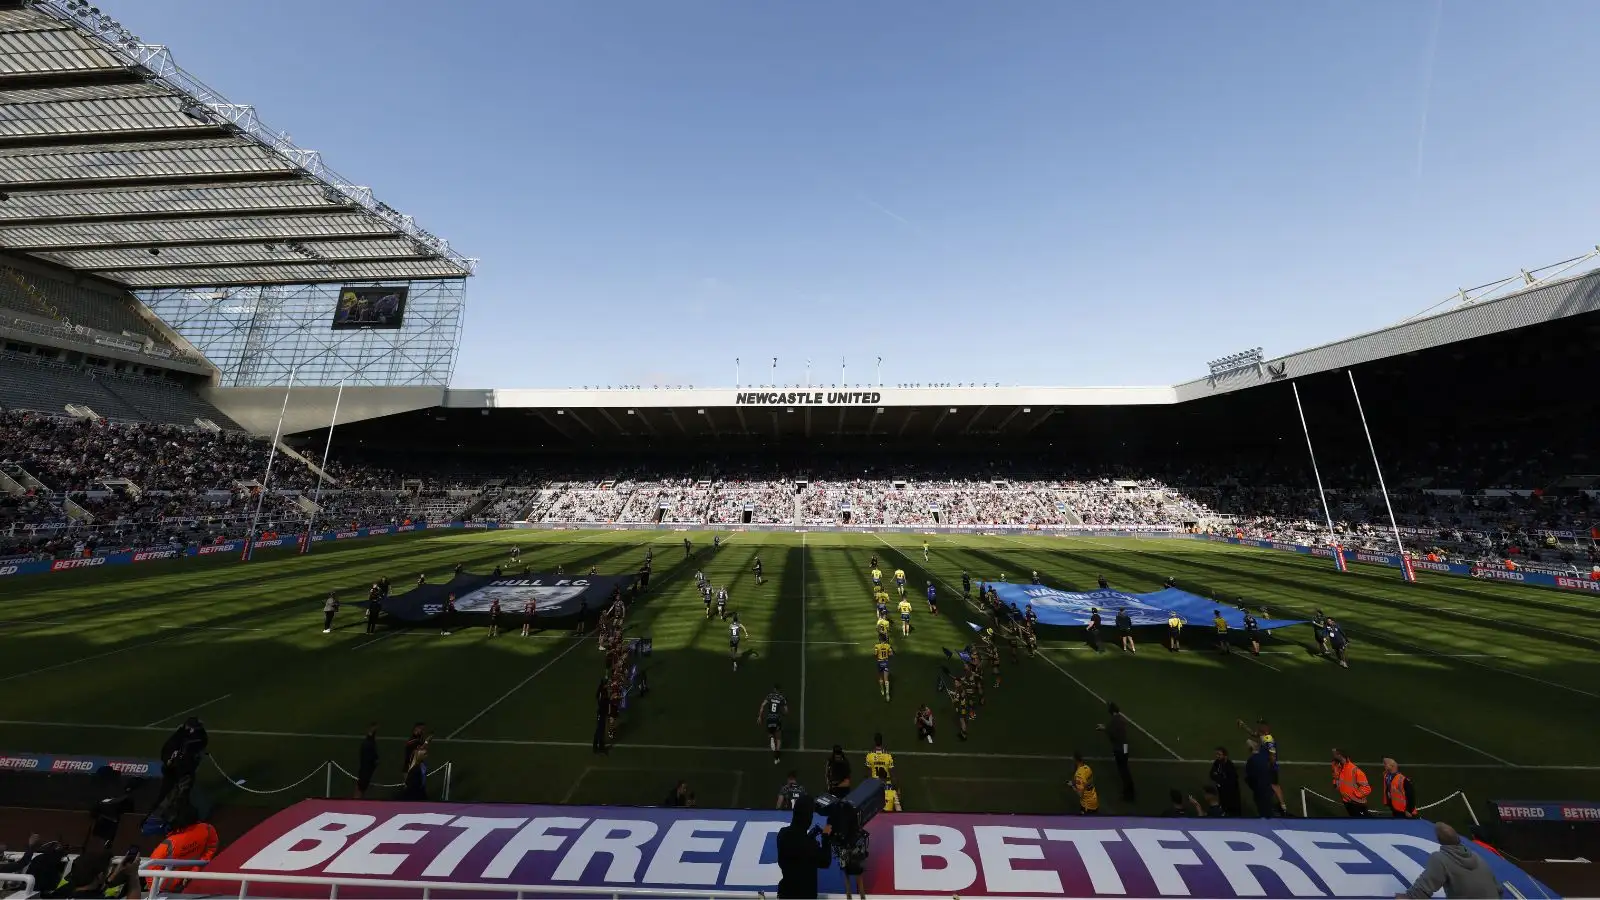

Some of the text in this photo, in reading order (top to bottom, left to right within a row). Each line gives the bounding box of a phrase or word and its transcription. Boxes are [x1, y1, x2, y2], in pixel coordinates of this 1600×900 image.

[736, 392, 880, 404] NEWCASTLE UNITED
[199, 544, 234, 554] BETFRED
[53, 557, 106, 570] BETFRED
[1357, 554, 1390, 563] BETFRED
[1412, 561, 1450, 571] BETFRED
[0, 757, 39, 768] BETFRED
[53, 760, 93, 770] BETFRED
[1498, 806, 1545, 818] BETFRED
